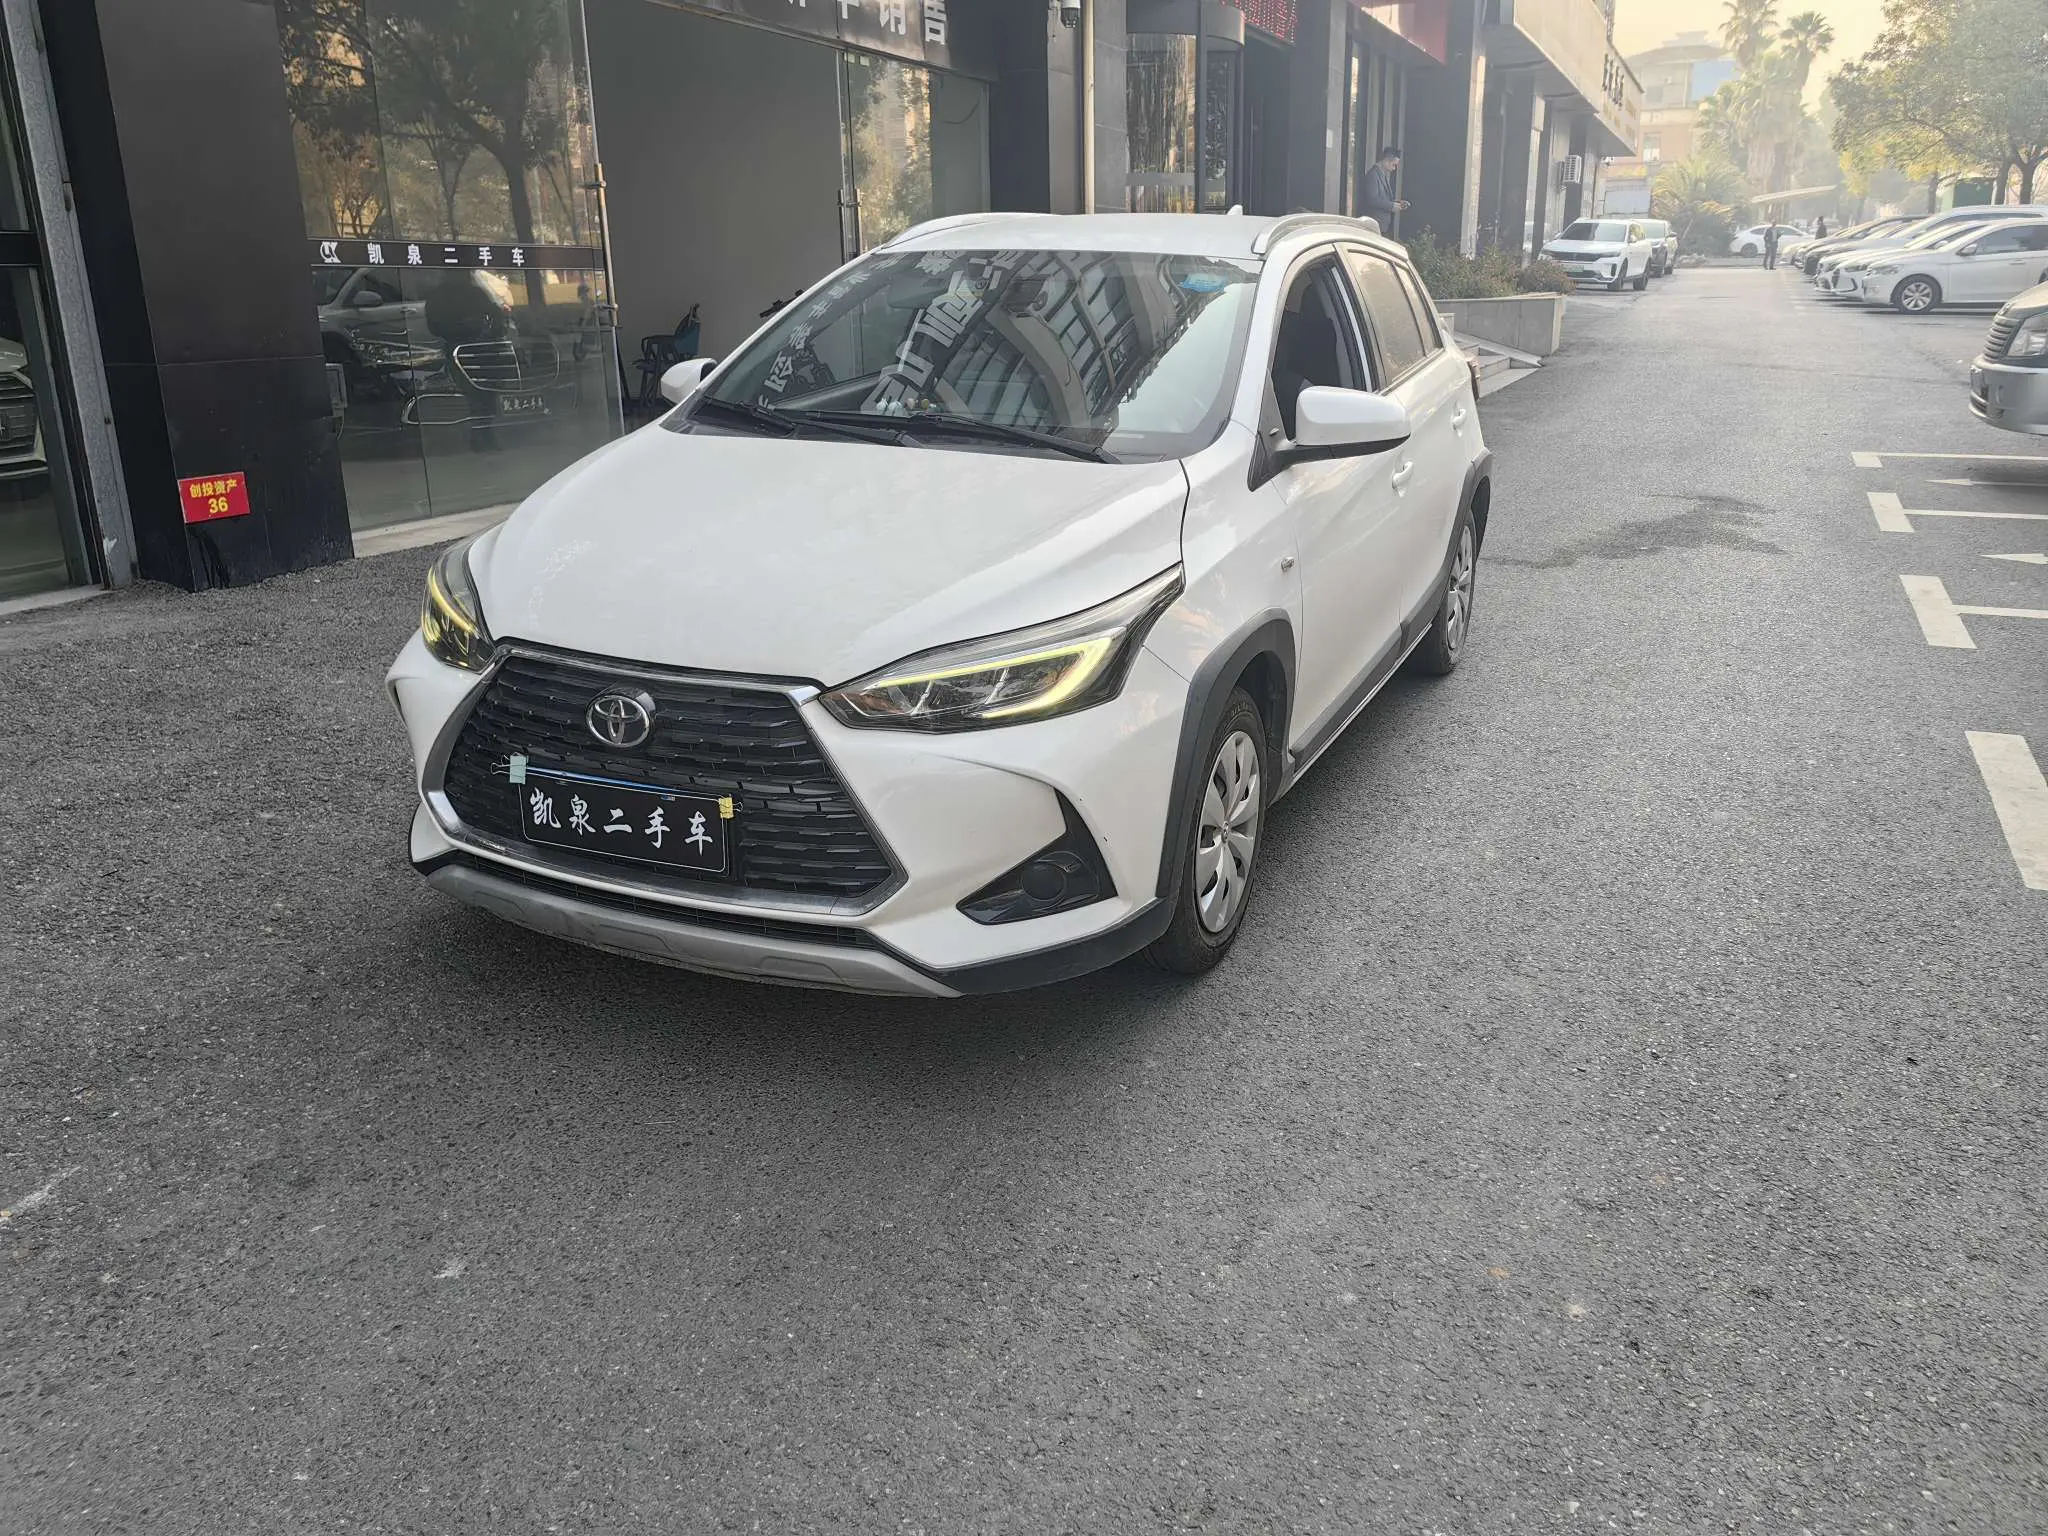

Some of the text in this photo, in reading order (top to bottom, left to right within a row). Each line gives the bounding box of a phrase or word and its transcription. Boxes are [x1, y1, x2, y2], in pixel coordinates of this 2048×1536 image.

[367, 243, 525, 266] 凯泉二手车
[189, 479, 238, 498] 创投资产
[208, 496, 229, 514] 36
[529, 787, 713, 856] 凯泉二手车
